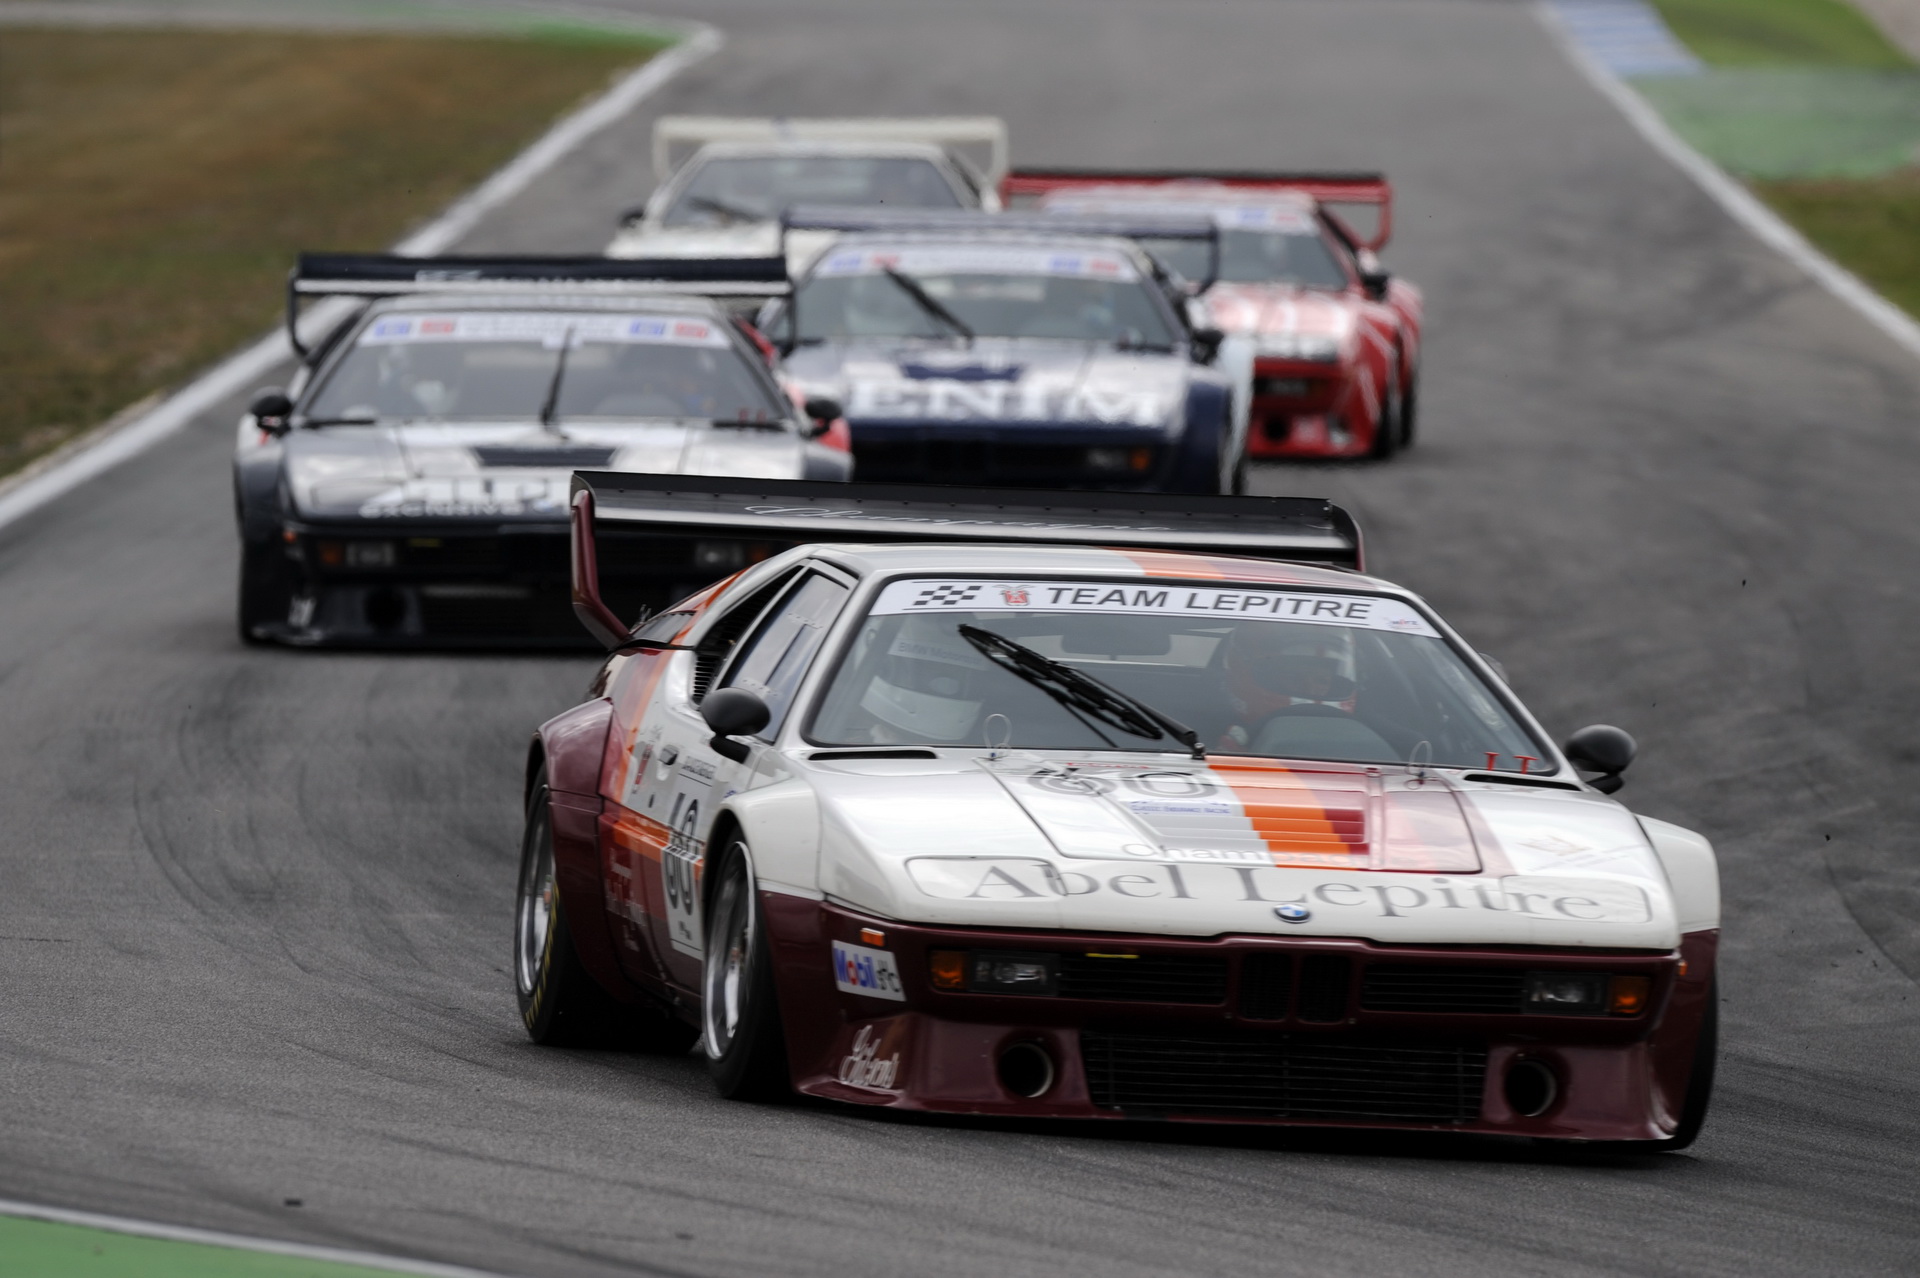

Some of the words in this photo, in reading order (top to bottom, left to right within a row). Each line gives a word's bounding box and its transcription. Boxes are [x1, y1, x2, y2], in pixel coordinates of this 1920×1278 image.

[1047, 586, 1168, 608] TEAM
[1183, 592, 1373, 621] LEPITRE
[964, 862, 1188, 901] Abel
[1228, 867, 1605, 921] Lepitre
[833, 947, 879, 990] Mobil
